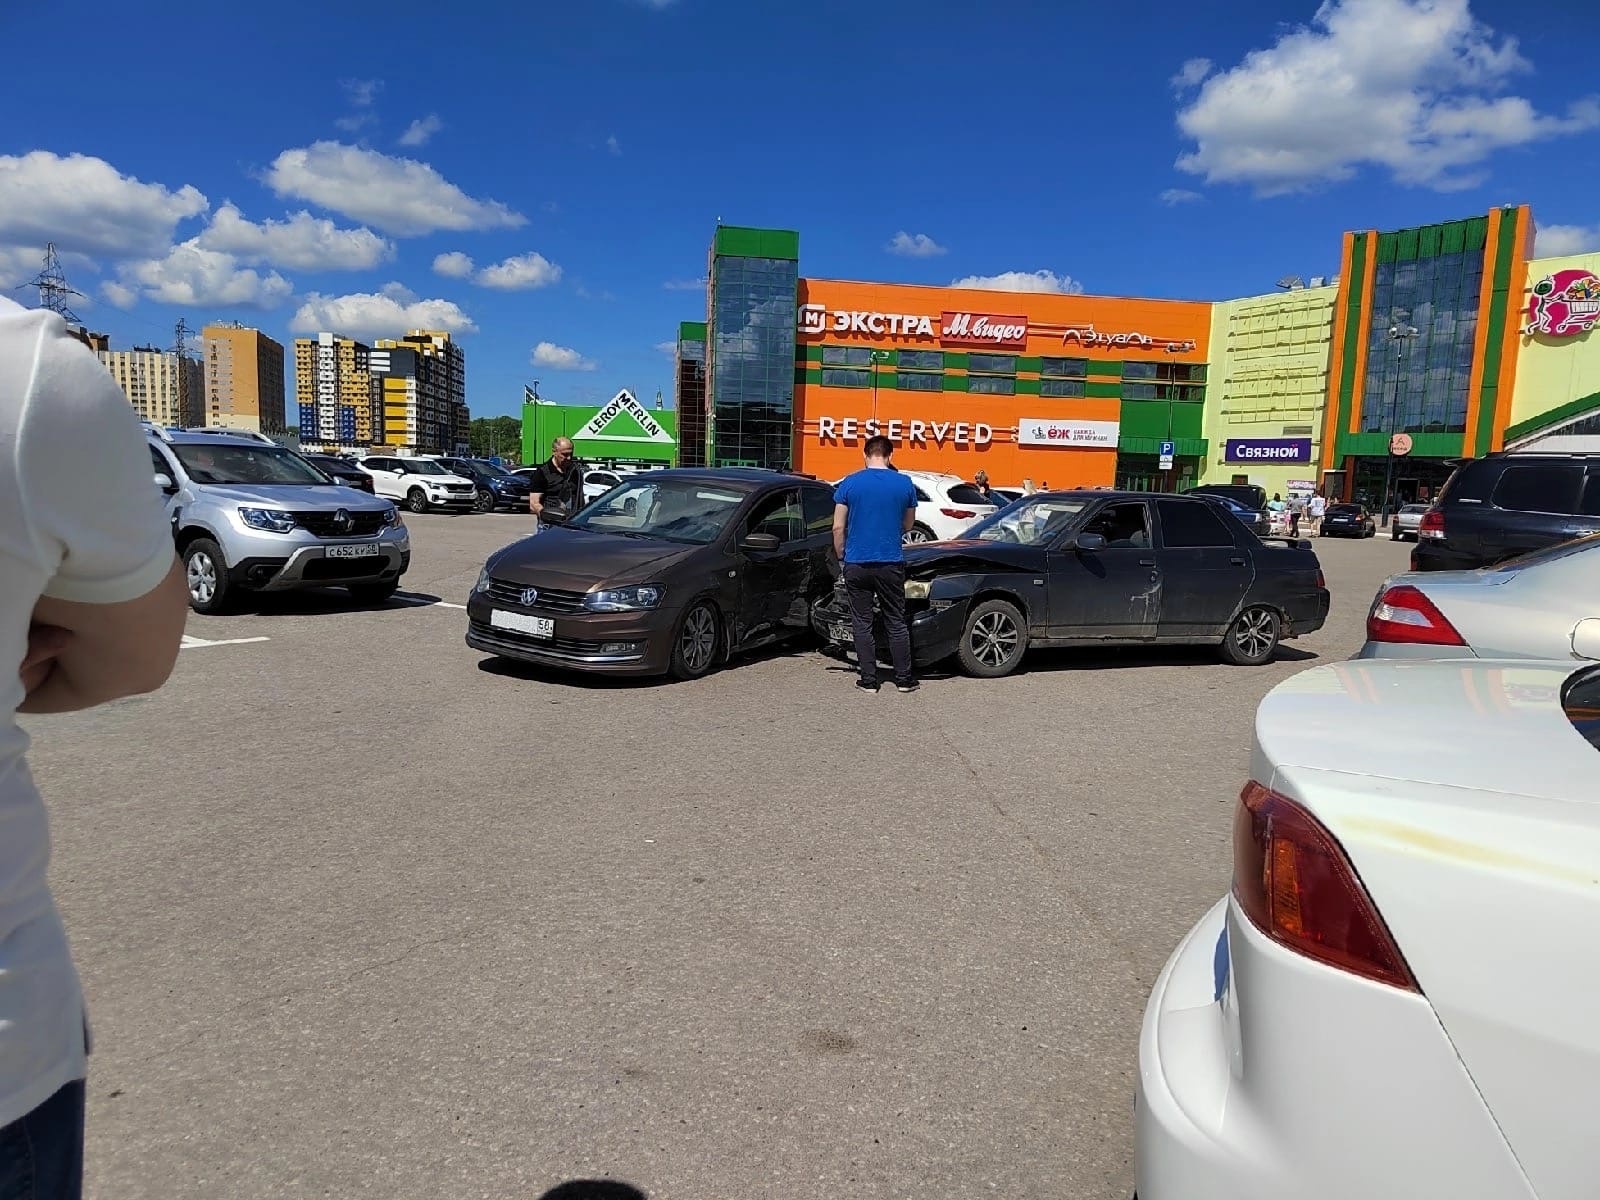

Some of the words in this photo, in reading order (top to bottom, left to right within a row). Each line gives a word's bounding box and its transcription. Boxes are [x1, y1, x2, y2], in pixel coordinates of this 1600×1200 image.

[833, 310, 934, 336] ЭКСТРА
[943, 313, 1026, 343] М.видео
[588, 400, 622, 434] LEROY
[618, 392, 660, 436] MERLIN
[818, 416, 993, 444] RESERVED
[1162, 443, 1171, 454] P
[1236, 443, 1299, 458] Связной
